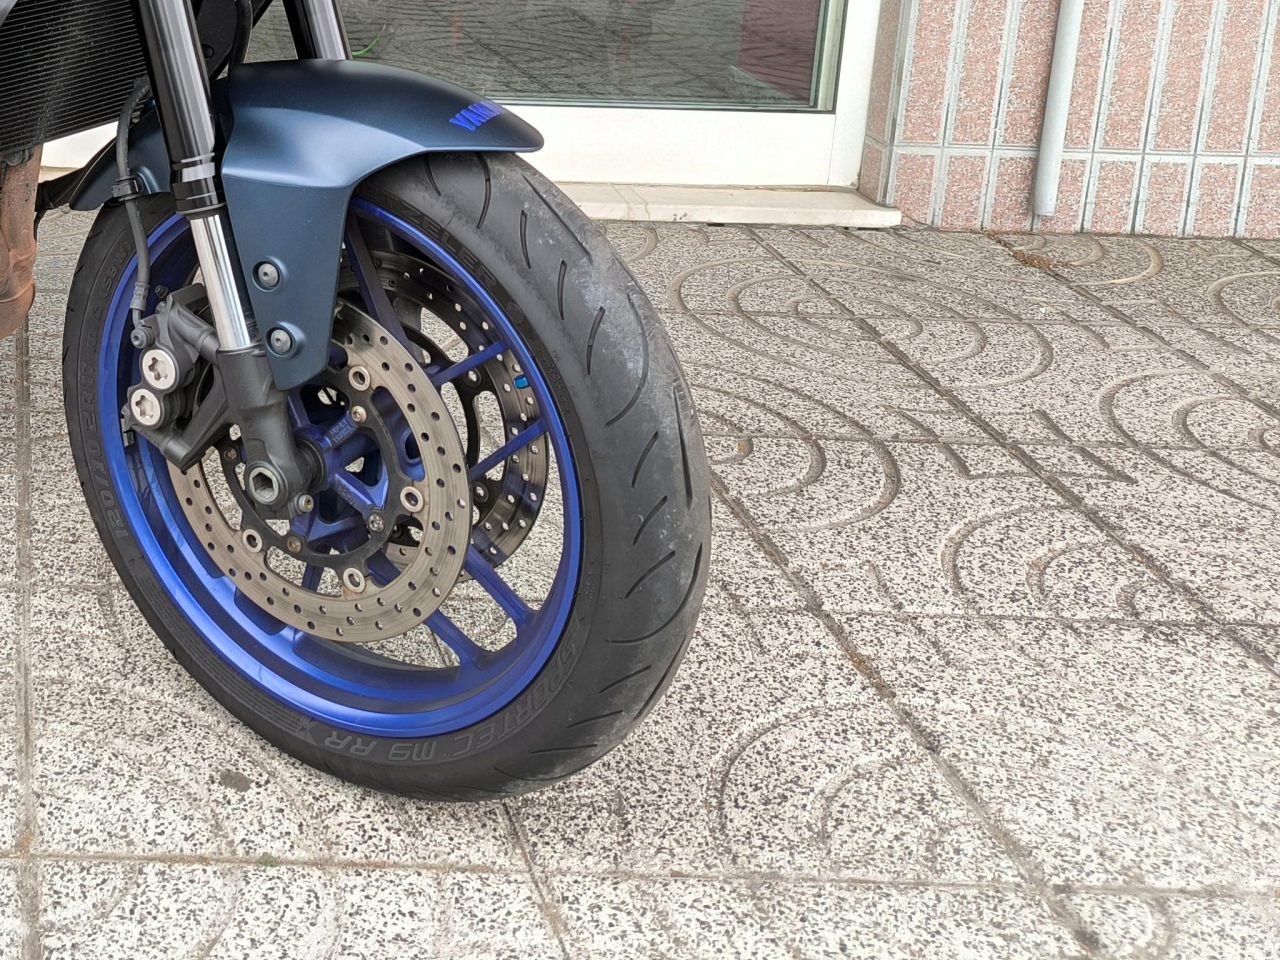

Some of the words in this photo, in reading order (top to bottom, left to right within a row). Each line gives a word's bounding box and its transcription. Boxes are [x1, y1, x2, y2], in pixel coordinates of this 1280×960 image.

[450, 632, 577, 758] SPORTEC
[323, 731, 377, 757] RR
[387, 741, 438, 761] M9
